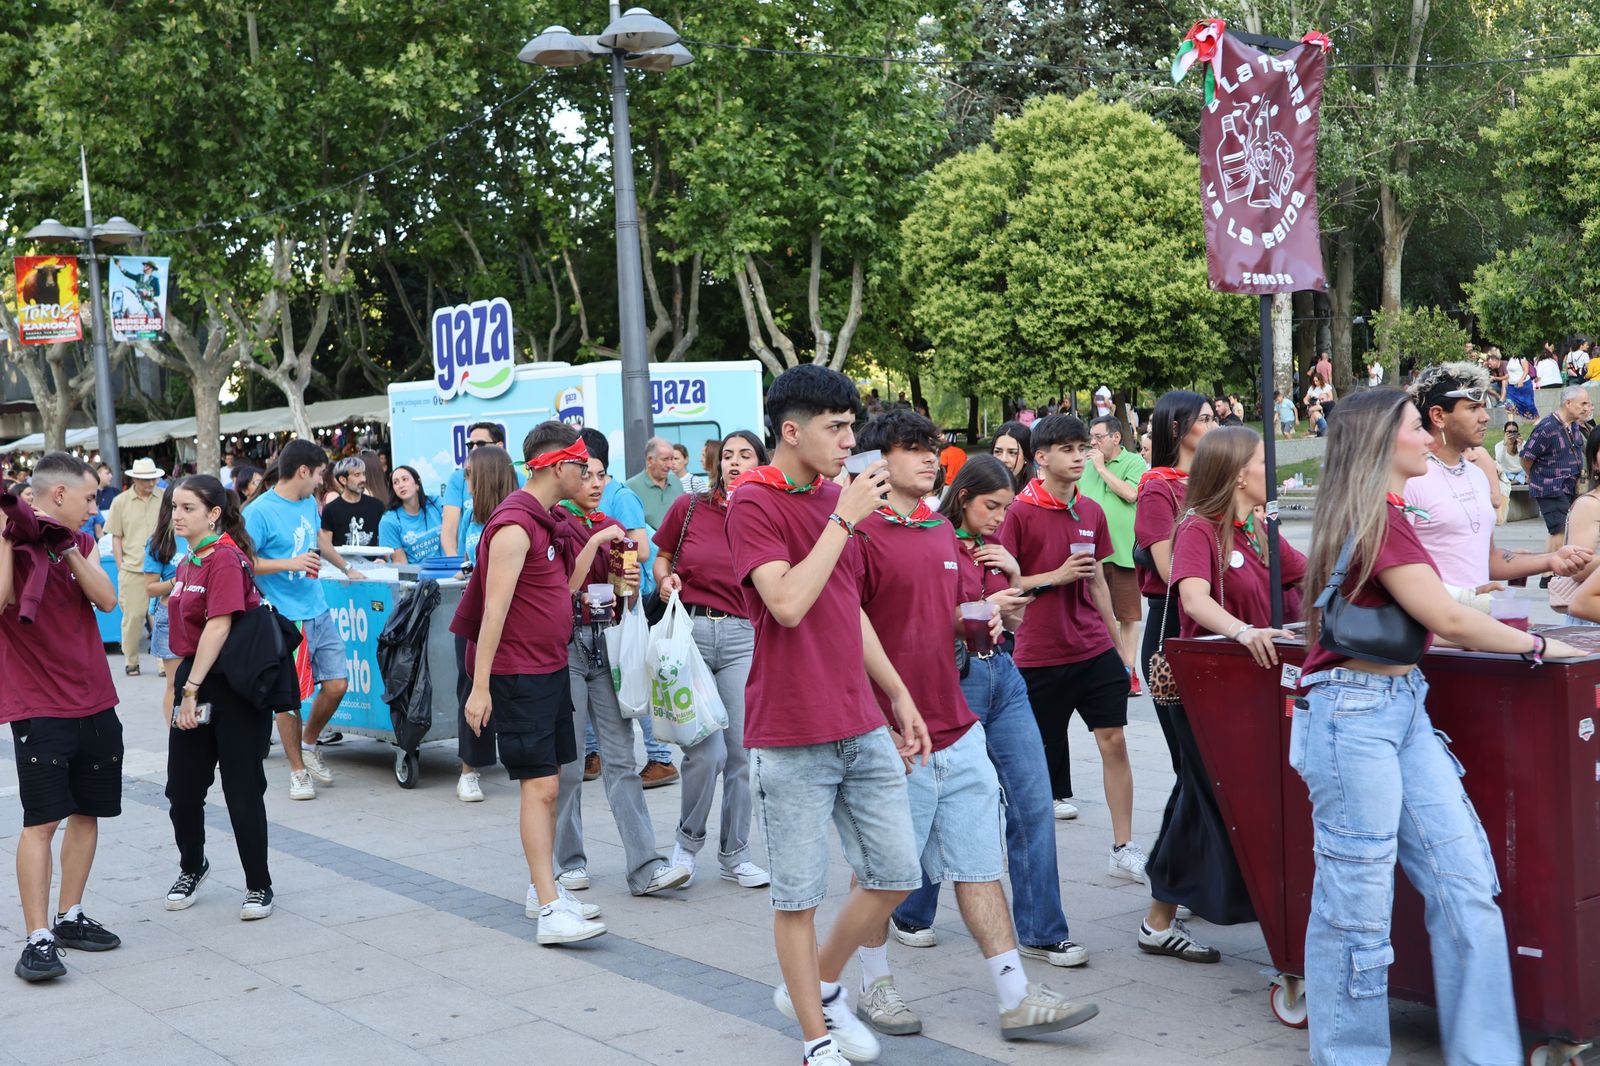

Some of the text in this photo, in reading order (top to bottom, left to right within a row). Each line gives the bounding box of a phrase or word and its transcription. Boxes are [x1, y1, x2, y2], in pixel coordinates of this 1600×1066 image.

[20, 302, 74, 321] TOROS
[23, 321, 77, 331] ZAMORA
[436, 303, 510, 391] gaza
[649, 379, 706, 415] gaza
